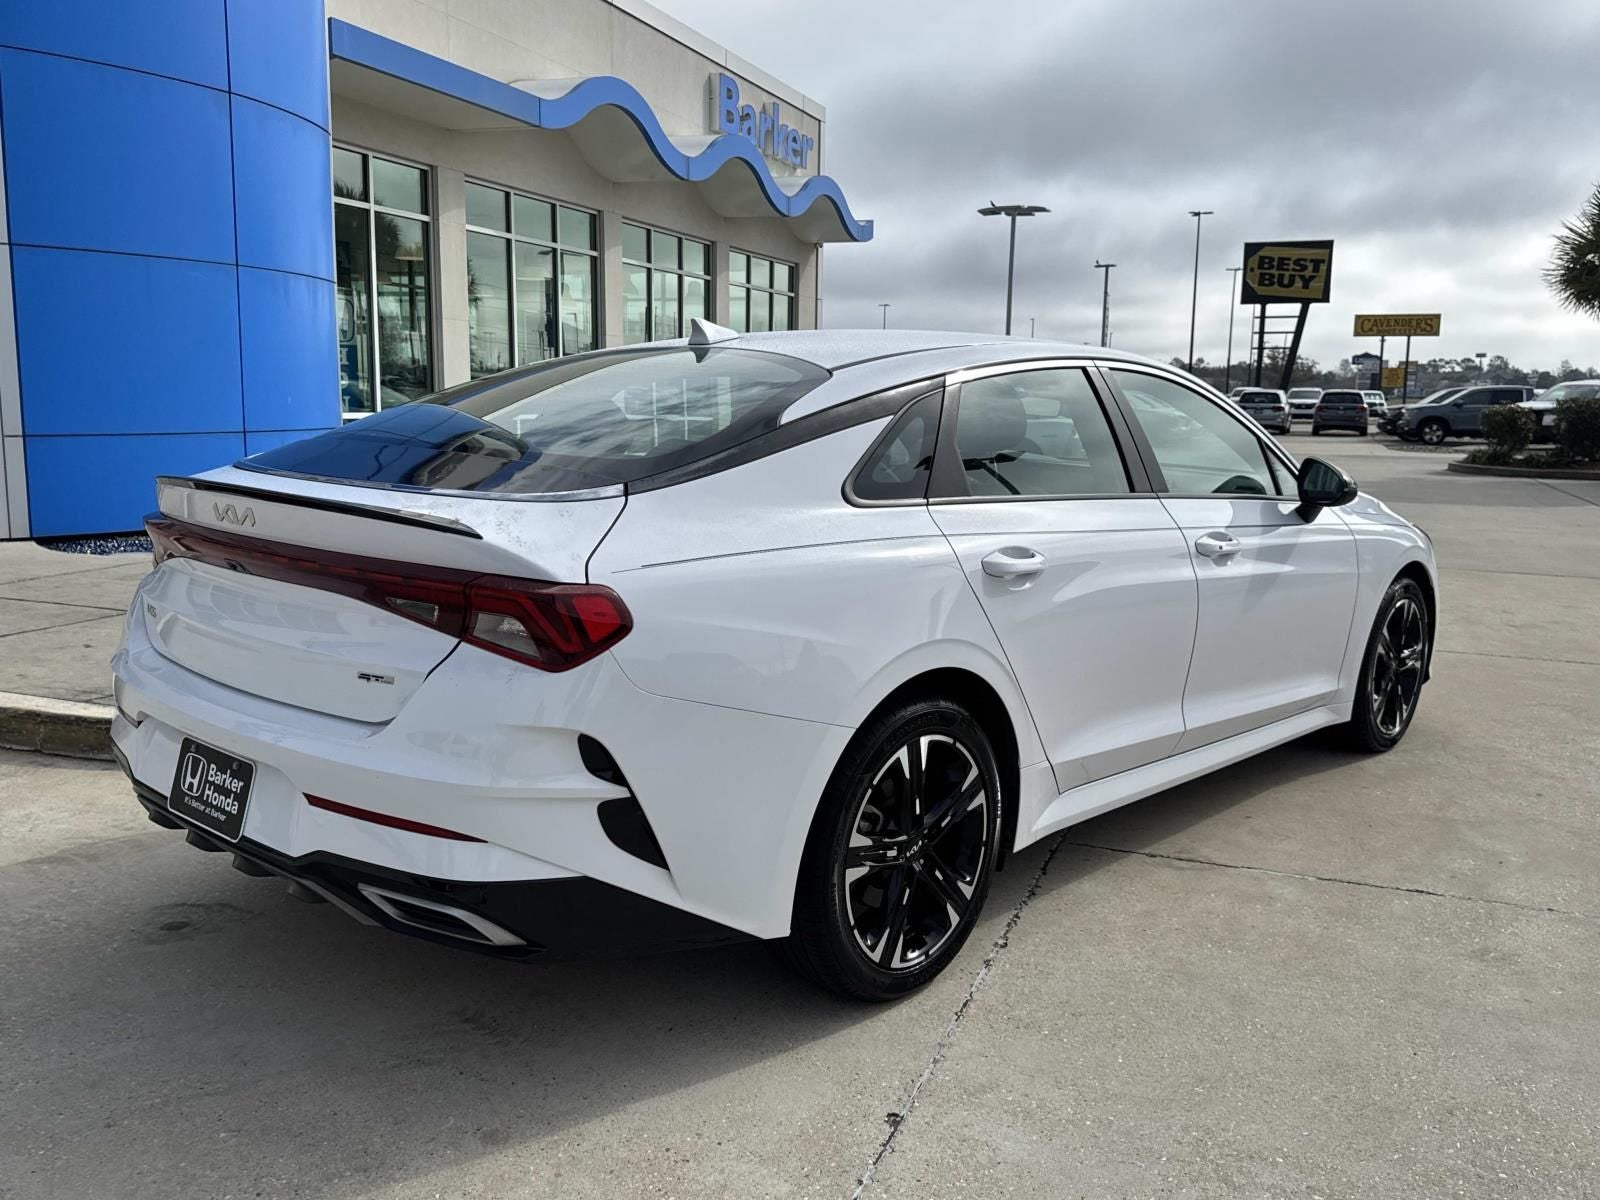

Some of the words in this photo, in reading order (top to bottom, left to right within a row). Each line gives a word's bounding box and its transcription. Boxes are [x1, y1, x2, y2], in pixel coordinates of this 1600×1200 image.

[718, 72, 814, 170] Barker
[1257, 255, 1326, 273] BEST
[1257, 272, 1316, 290] BUY
[212, 501, 257, 528] KIA
[208, 763, 244, 794] Barker
[203, 783, 239, 815] Honda
